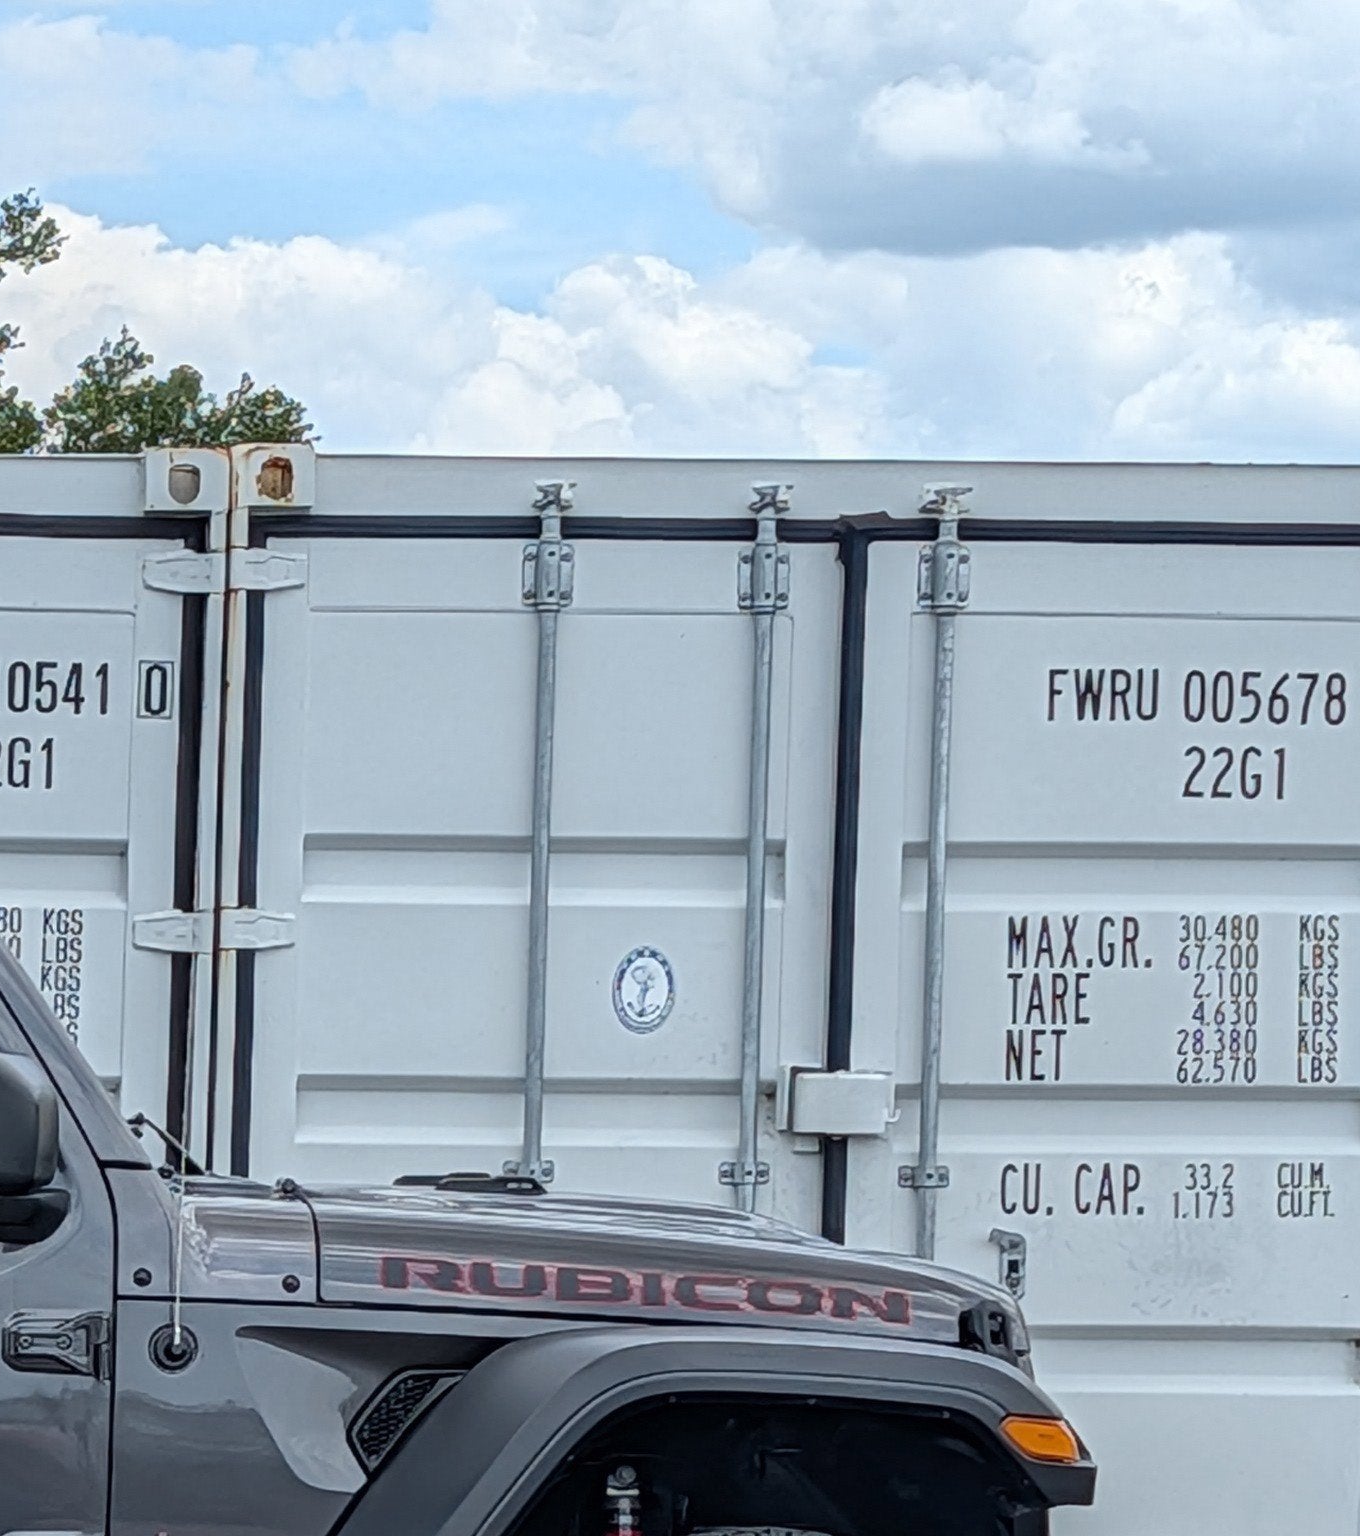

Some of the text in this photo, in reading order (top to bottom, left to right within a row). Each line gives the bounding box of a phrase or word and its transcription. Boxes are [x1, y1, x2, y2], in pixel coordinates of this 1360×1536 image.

[143, 662, 168, 716] 0
[1047, 668, 1347, 726] FWRU 005678
[1182, 746, 1286, 800] 22G1
[42, 908, 84, 935] KGS
[1179, 914, 1340, 942] 30.480 KGS
[41, 937, 83, 963] LBS
[1178, 943, 1339, 971] 67.200 LBS
[40, 965, 81, 992] KGS
[1193, 971, 1339, 999] 2.100 KGS
[1007, 972, 1091, 1025] TARE
[1191, 1000, 1339, 1027] 4.630 LBS
[1005, 1028, 1068, 1081] NET
[1176, 1028, 1338, 1055] 28.380 KGS
[1176, 1056, 1338, 1084] 62.570 LBS
[1000, 1162, 1145, 1216] CU. CAP.
[381, 1256, 912, 1326] RUBICON
